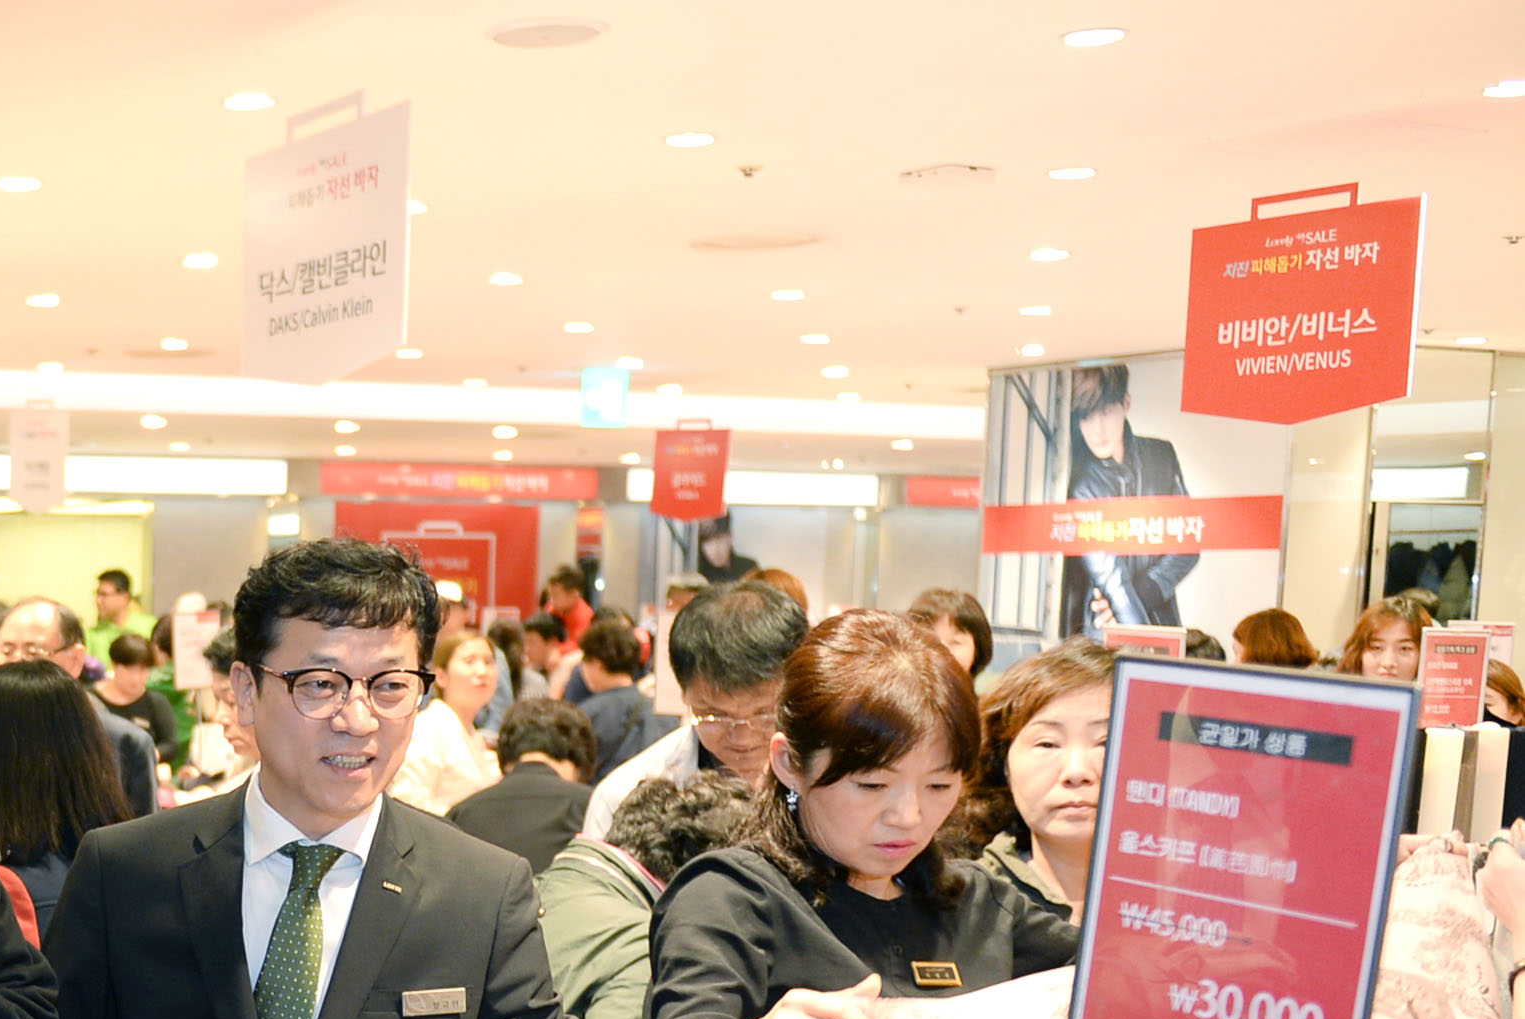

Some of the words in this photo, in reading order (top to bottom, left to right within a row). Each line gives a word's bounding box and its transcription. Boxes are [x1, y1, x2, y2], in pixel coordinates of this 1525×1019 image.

[327, 174, 354, 201] 자선
[354, 164, 380, 193] 바자
[259, 239, 387, 304] 닥스/캘빈클라인
[1223, 259, 1250, 278] 지진
[1251, 252, 1303, 276] 피해돕기
[1305, 246, 1340, 271] 자선
[1343, 241, 1380, 267] 바자
[269, 303, 339, 337] DAKS/Calvin
[342, 296, 374, 322] Klein
[1217, 307, 1378, 349] 비비안/비너스
[1235, 348, 1352, 377] VIVIEN/VENUS
[1129, 516, 1164, 544] 자선
[1167, 516, 1204, 543] 바자
[1198, 721, 1260, 750] 균일가
[1264, 731, 1308, 758] 상품
